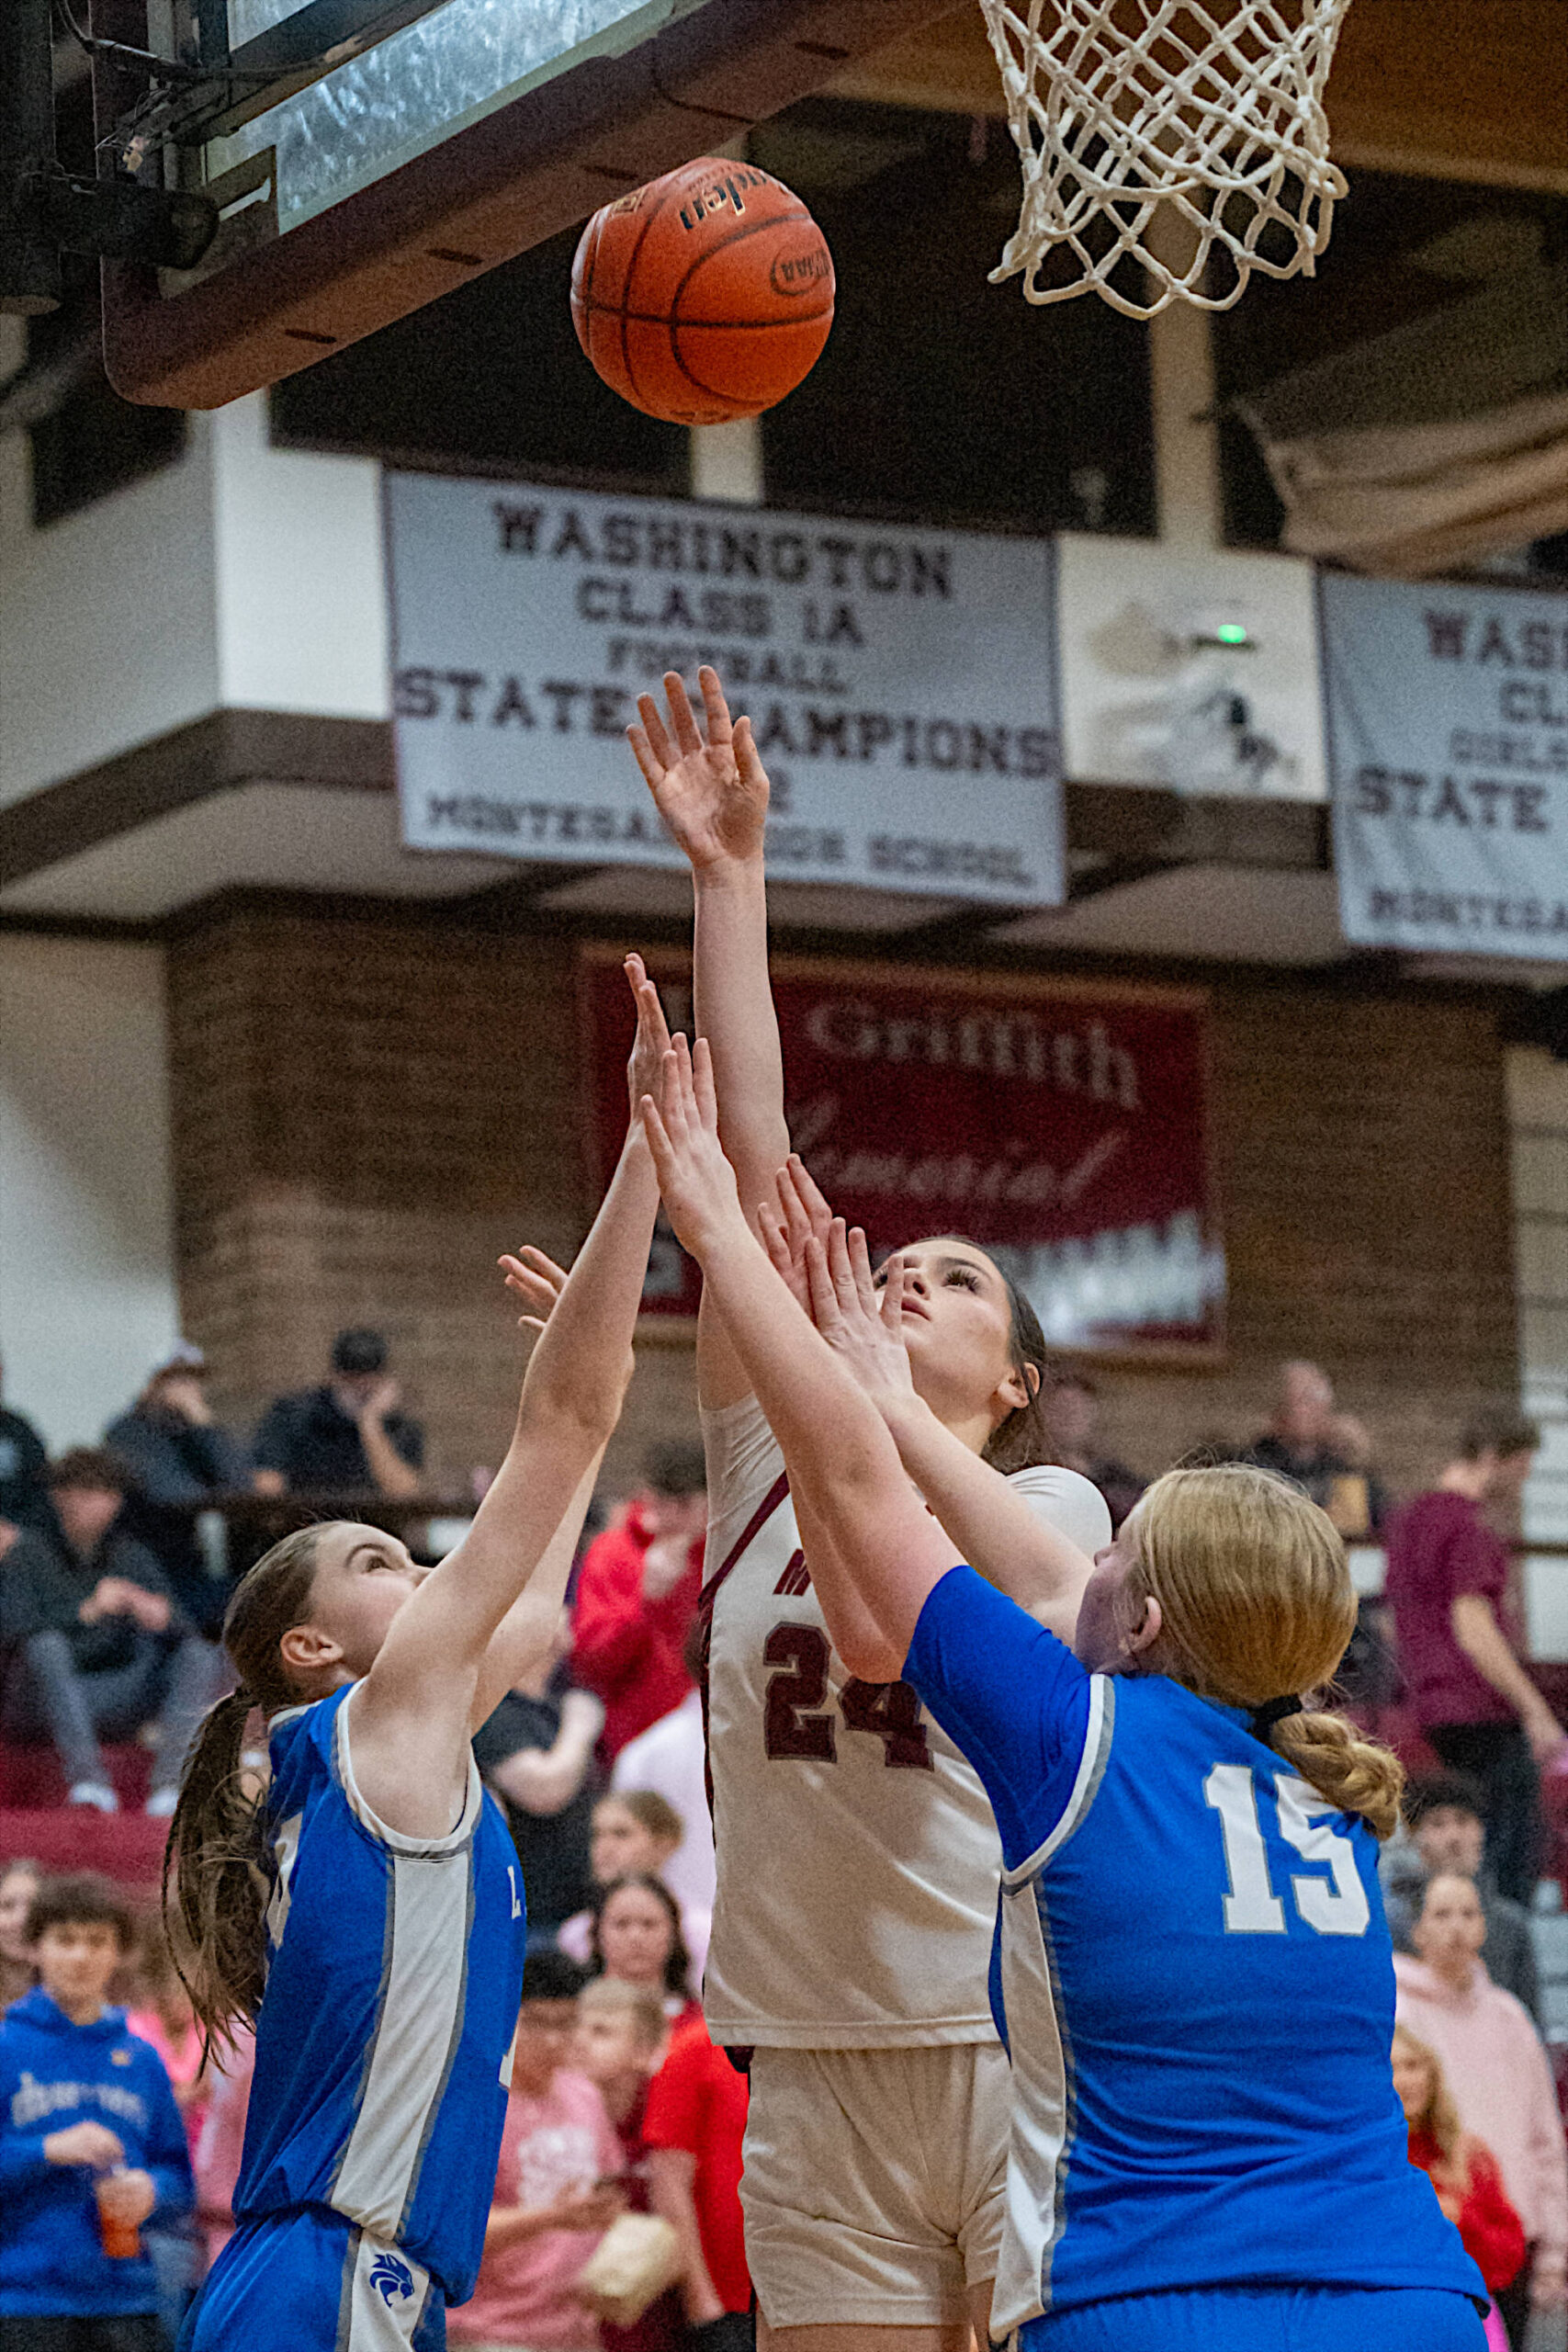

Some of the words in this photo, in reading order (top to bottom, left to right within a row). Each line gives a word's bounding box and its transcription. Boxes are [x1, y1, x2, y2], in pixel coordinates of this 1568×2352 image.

[491, 501, 953, 600] WASHINGTON
[576, 576, 772, 639] CLASS
[392, 666, 630, 735] STATE
[1357, 763, 1549, 834] STATE
[763, 1622, 935, 1772] 24
[1202, 1761, 1371, 1938] 15
